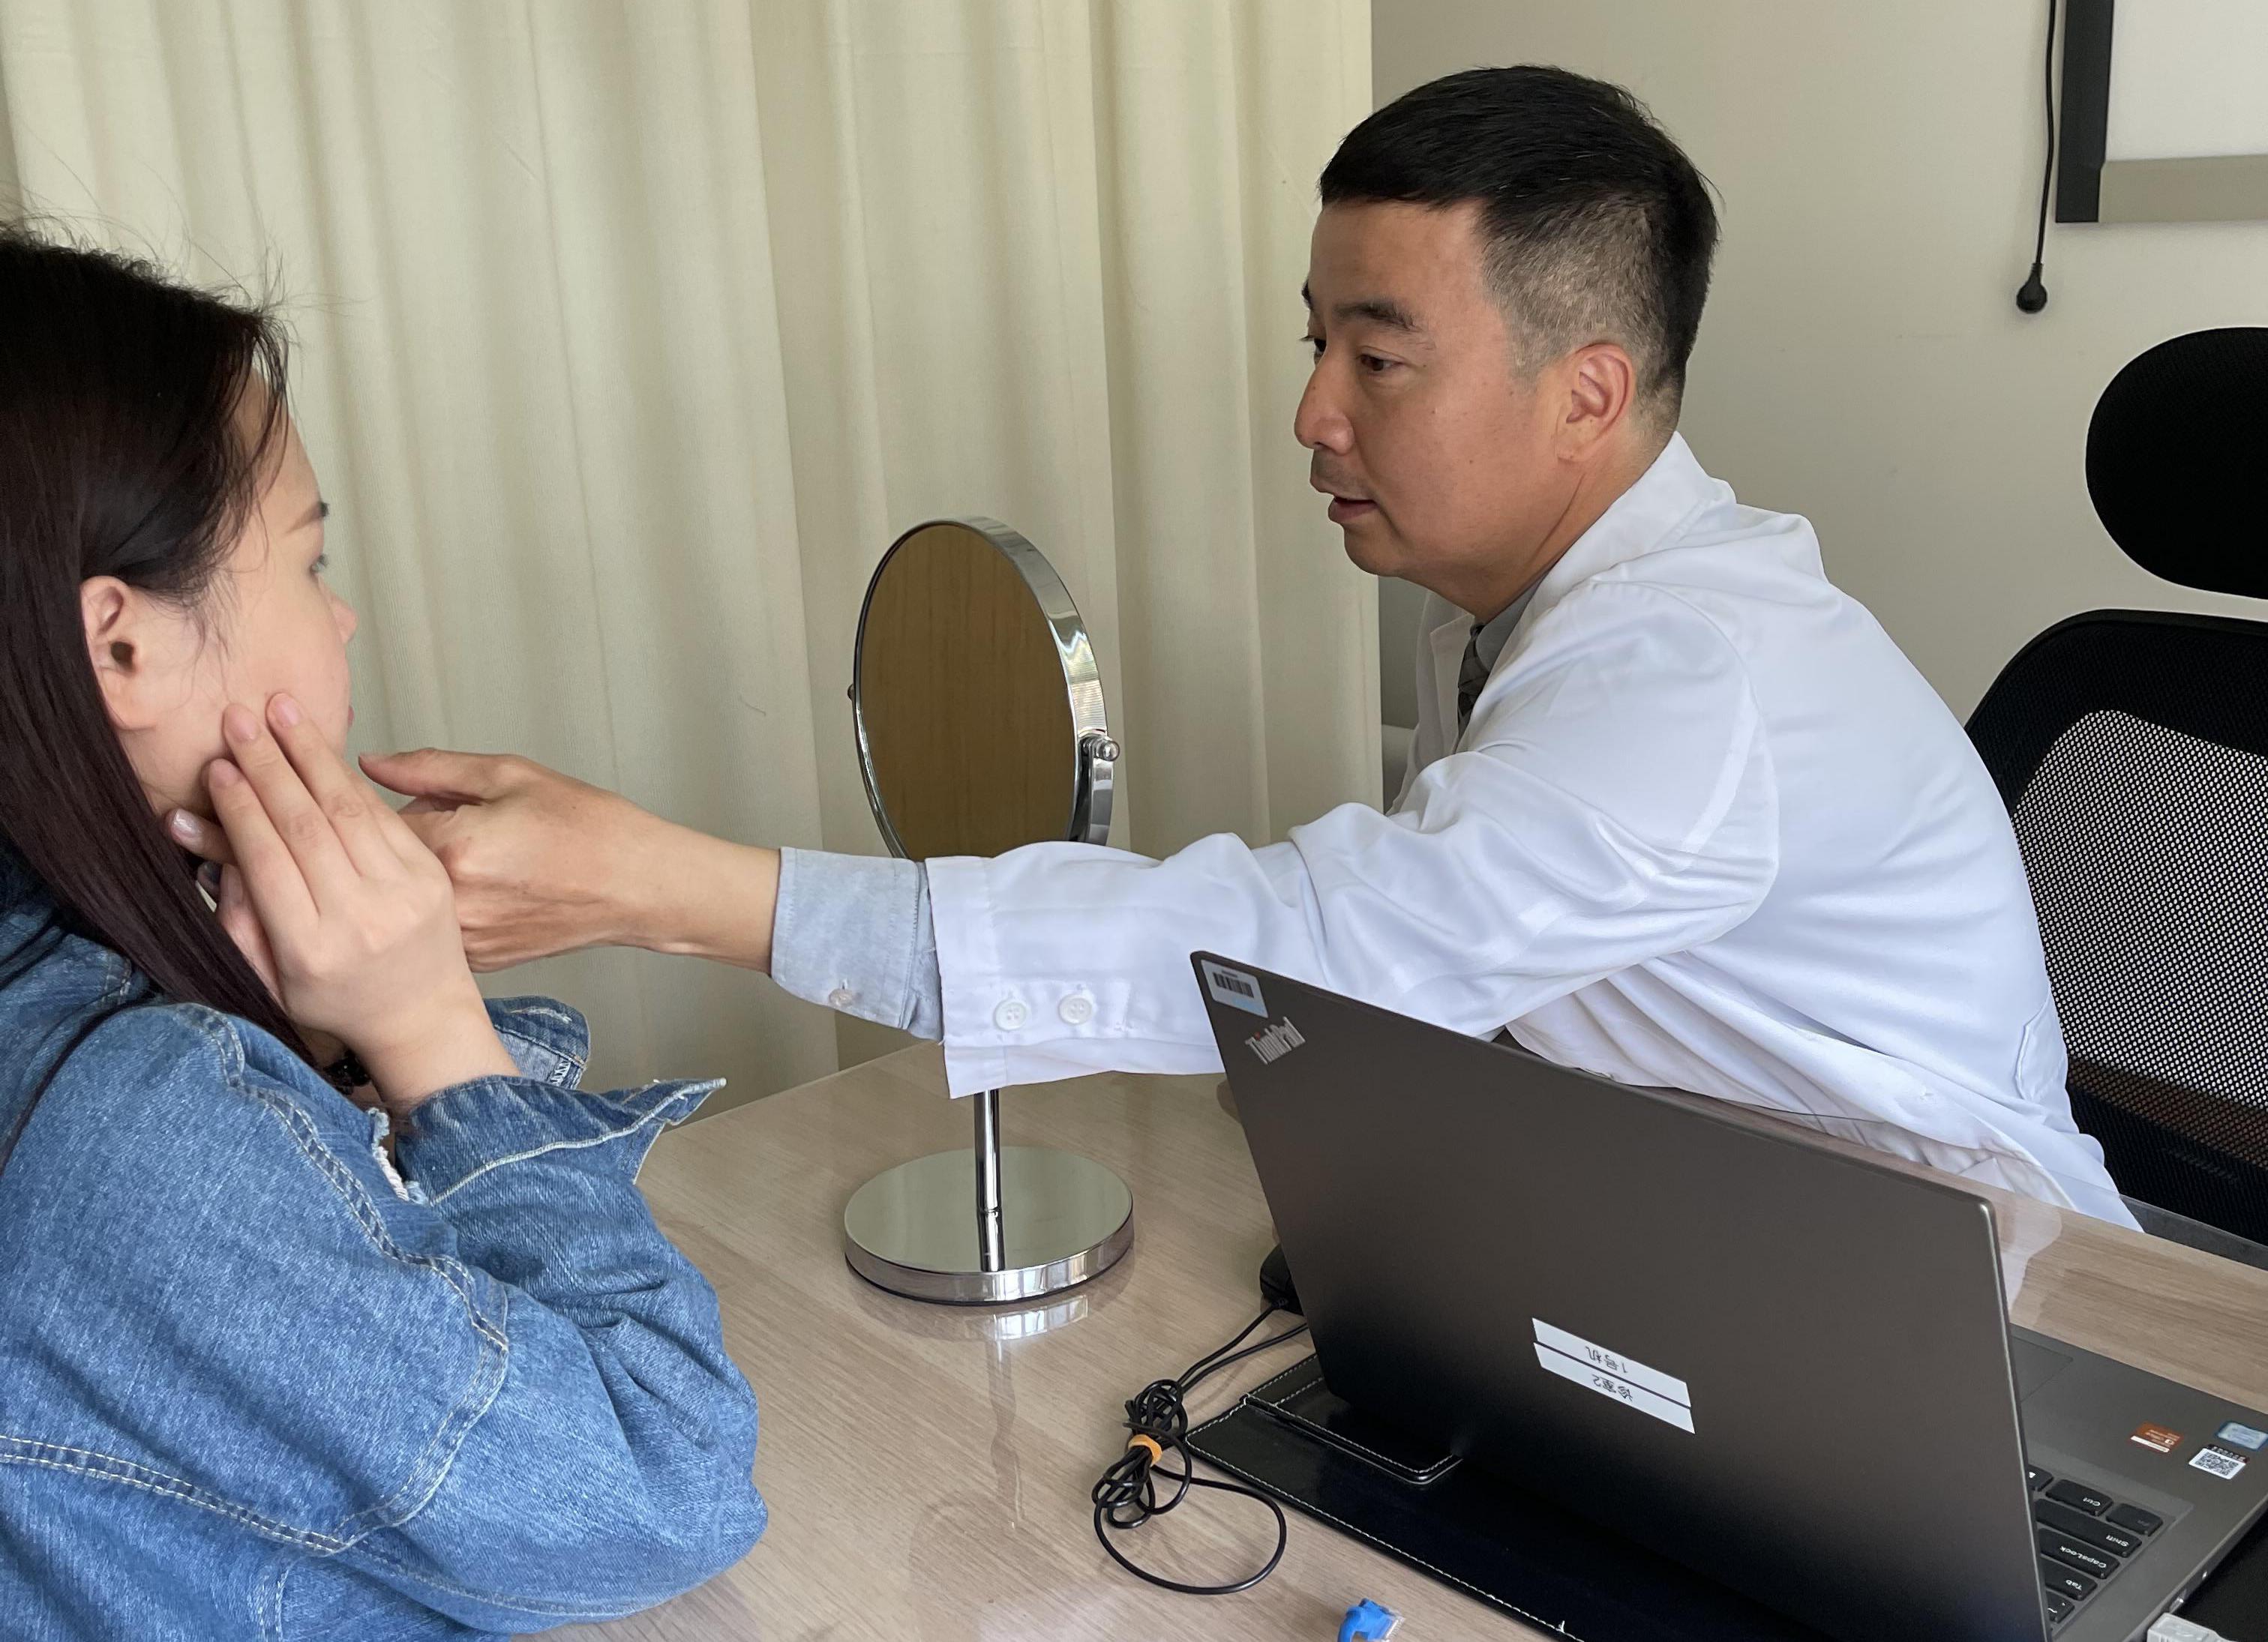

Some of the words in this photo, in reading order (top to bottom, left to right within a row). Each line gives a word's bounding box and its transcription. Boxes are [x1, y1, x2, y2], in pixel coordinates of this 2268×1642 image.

[1245, 1017, 1306, 1065] ThinkPad
[1585, 1346, 1628, 1374] 1号机
[1592, 1374, 1634, 1401] 诊室2
[2083, 1497, 2101, 1507] Ctrl
[2105, 1535, 2130, 1548] Shift
[2060, 1546, 2107, 1569] CapsLock
[2066, 1579, 2083, 1591] Tab
